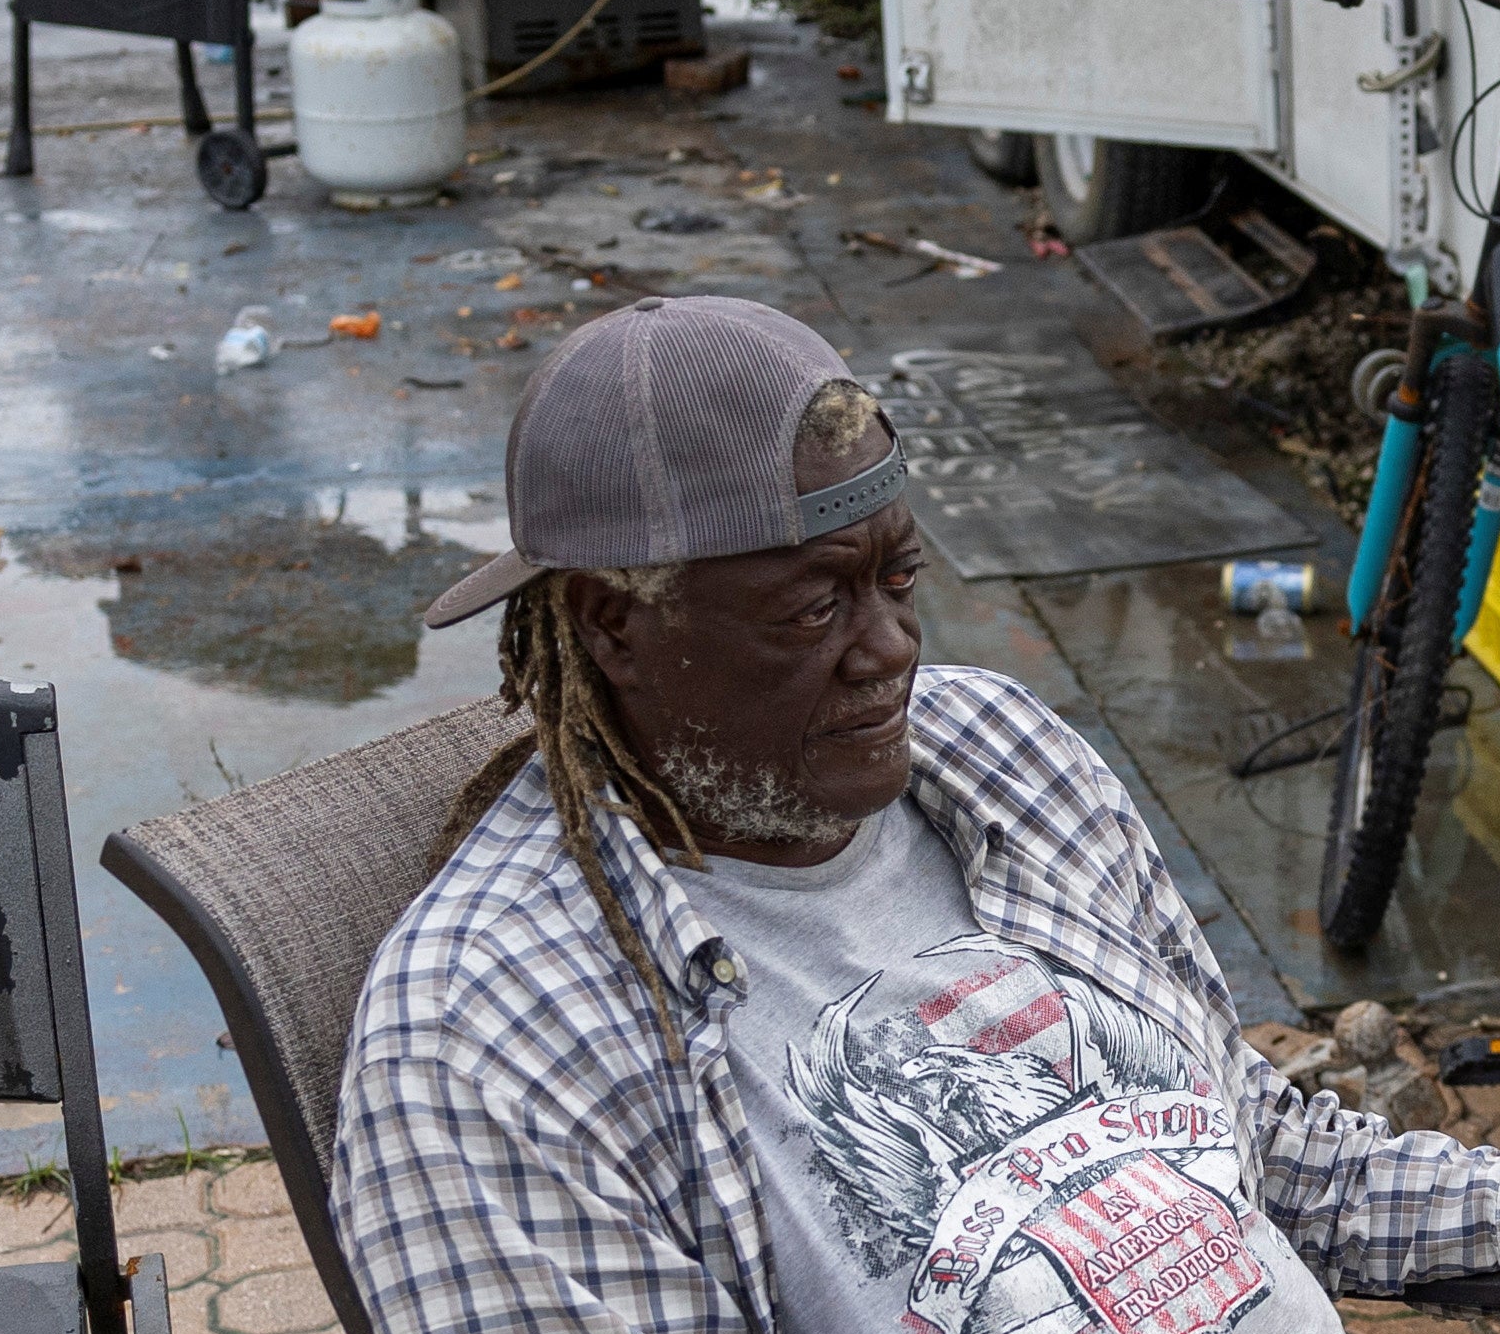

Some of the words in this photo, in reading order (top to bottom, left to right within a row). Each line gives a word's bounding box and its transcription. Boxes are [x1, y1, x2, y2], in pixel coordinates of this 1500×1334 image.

[913, 1199, 1005, 1302] Bass
[987, 1131, 1091, 1197] Pro
[1099, 1097, 1231, 1145] Shops
[1060, 1182, 1089, 1201] Est.
[1086, 1163, 1116, 1185] 1972
[1102, 1191, 1140, 1222] AN
[1085, 1192, 1215, 1292] AMERICAN
[1112, 1227, 1242, 1327] TRADITION
